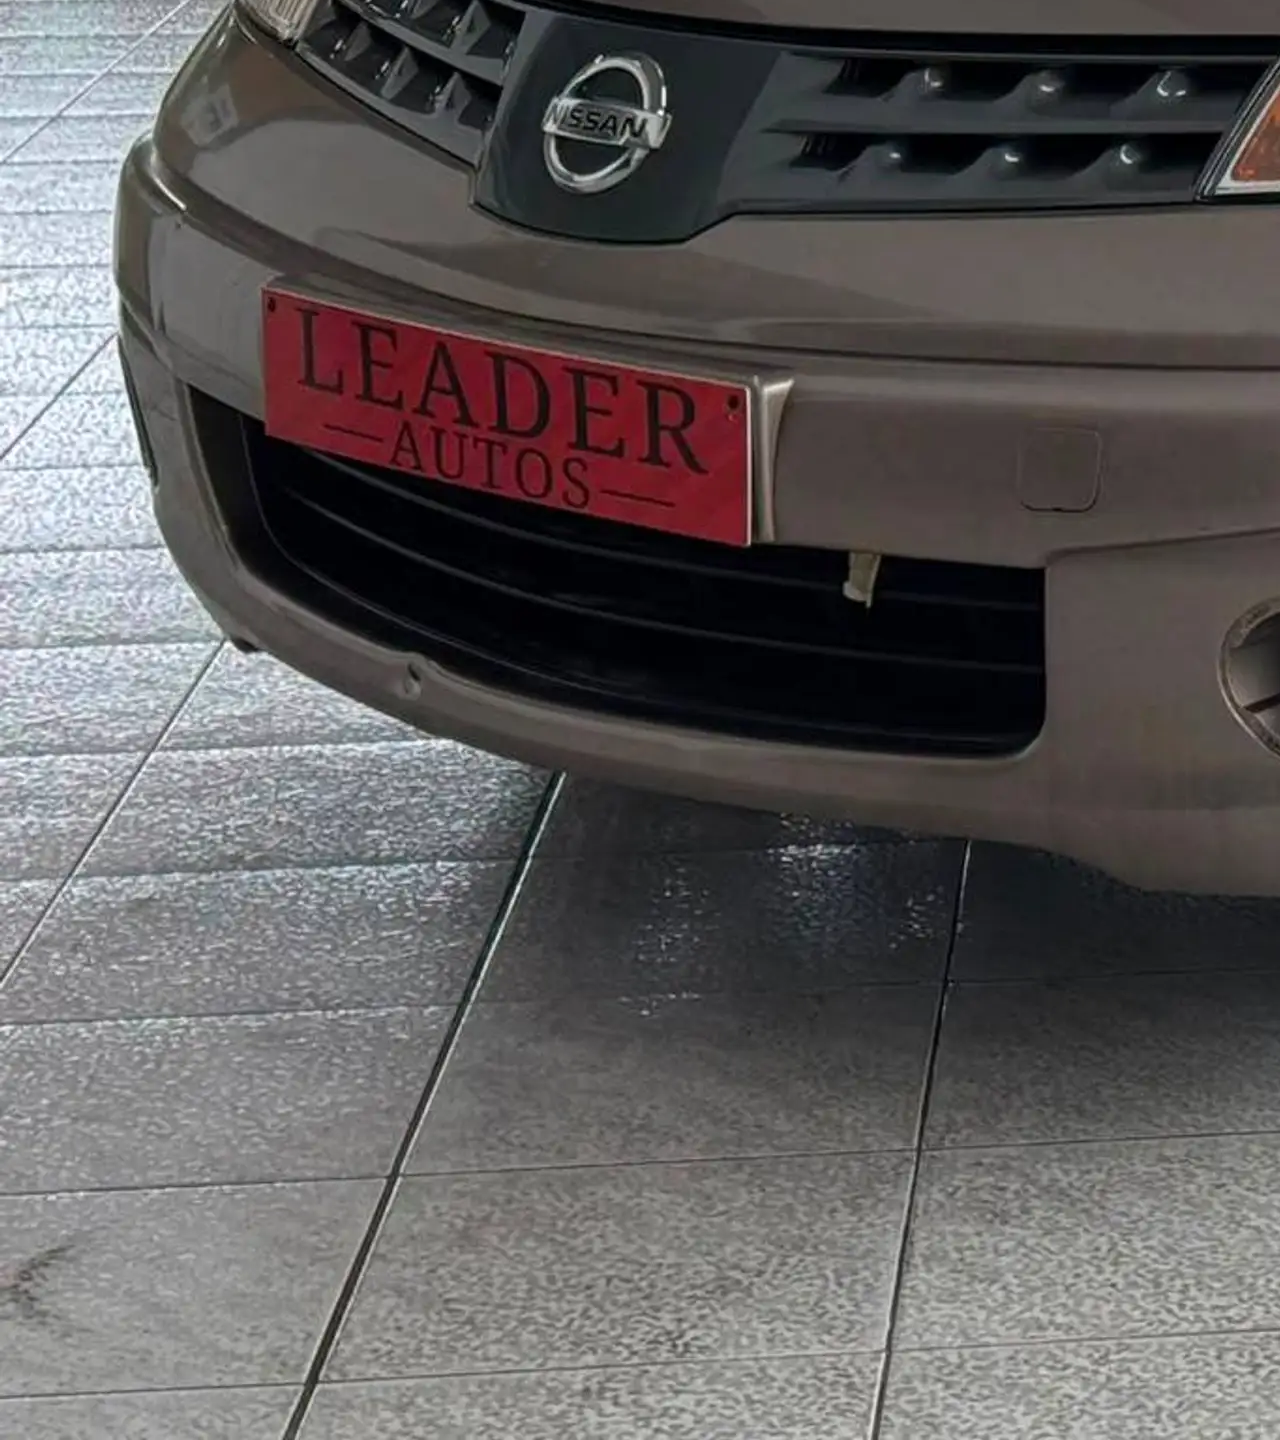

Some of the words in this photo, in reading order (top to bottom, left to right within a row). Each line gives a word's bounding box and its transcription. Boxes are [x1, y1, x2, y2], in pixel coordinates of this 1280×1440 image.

[543, 97, 648, 139] NISSAN
[296, 308, 709, 474] LEADER
[389, 422, 591, 509] AUTOS
